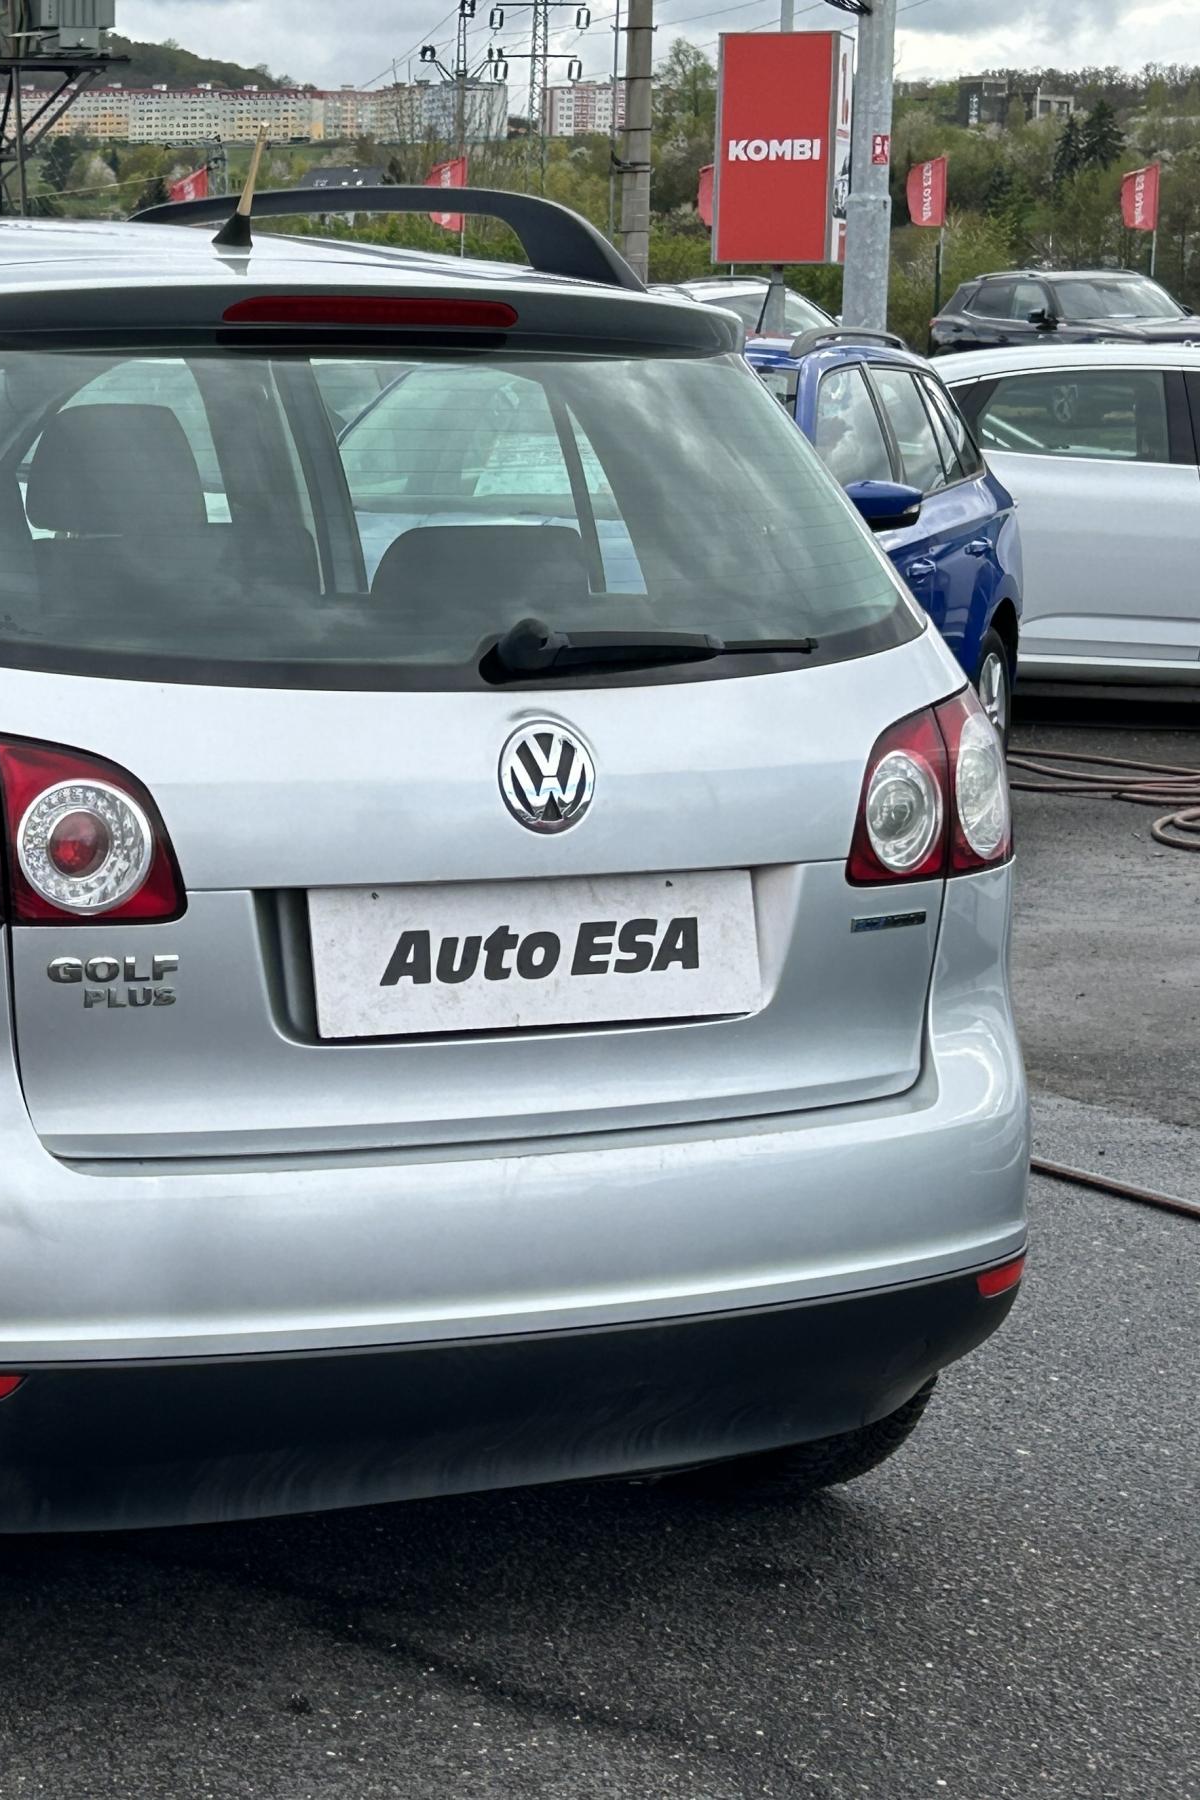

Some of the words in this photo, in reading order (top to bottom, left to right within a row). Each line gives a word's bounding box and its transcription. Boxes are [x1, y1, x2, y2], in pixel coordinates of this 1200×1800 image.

[728, 138, 821, 161] KOMBI
[379, 925, 561, 986] Auto
[570, 916, 700, 976] ESA
[46, 954, 180, 983] GOLF
[83, 985, 177, 1009] PLUS
